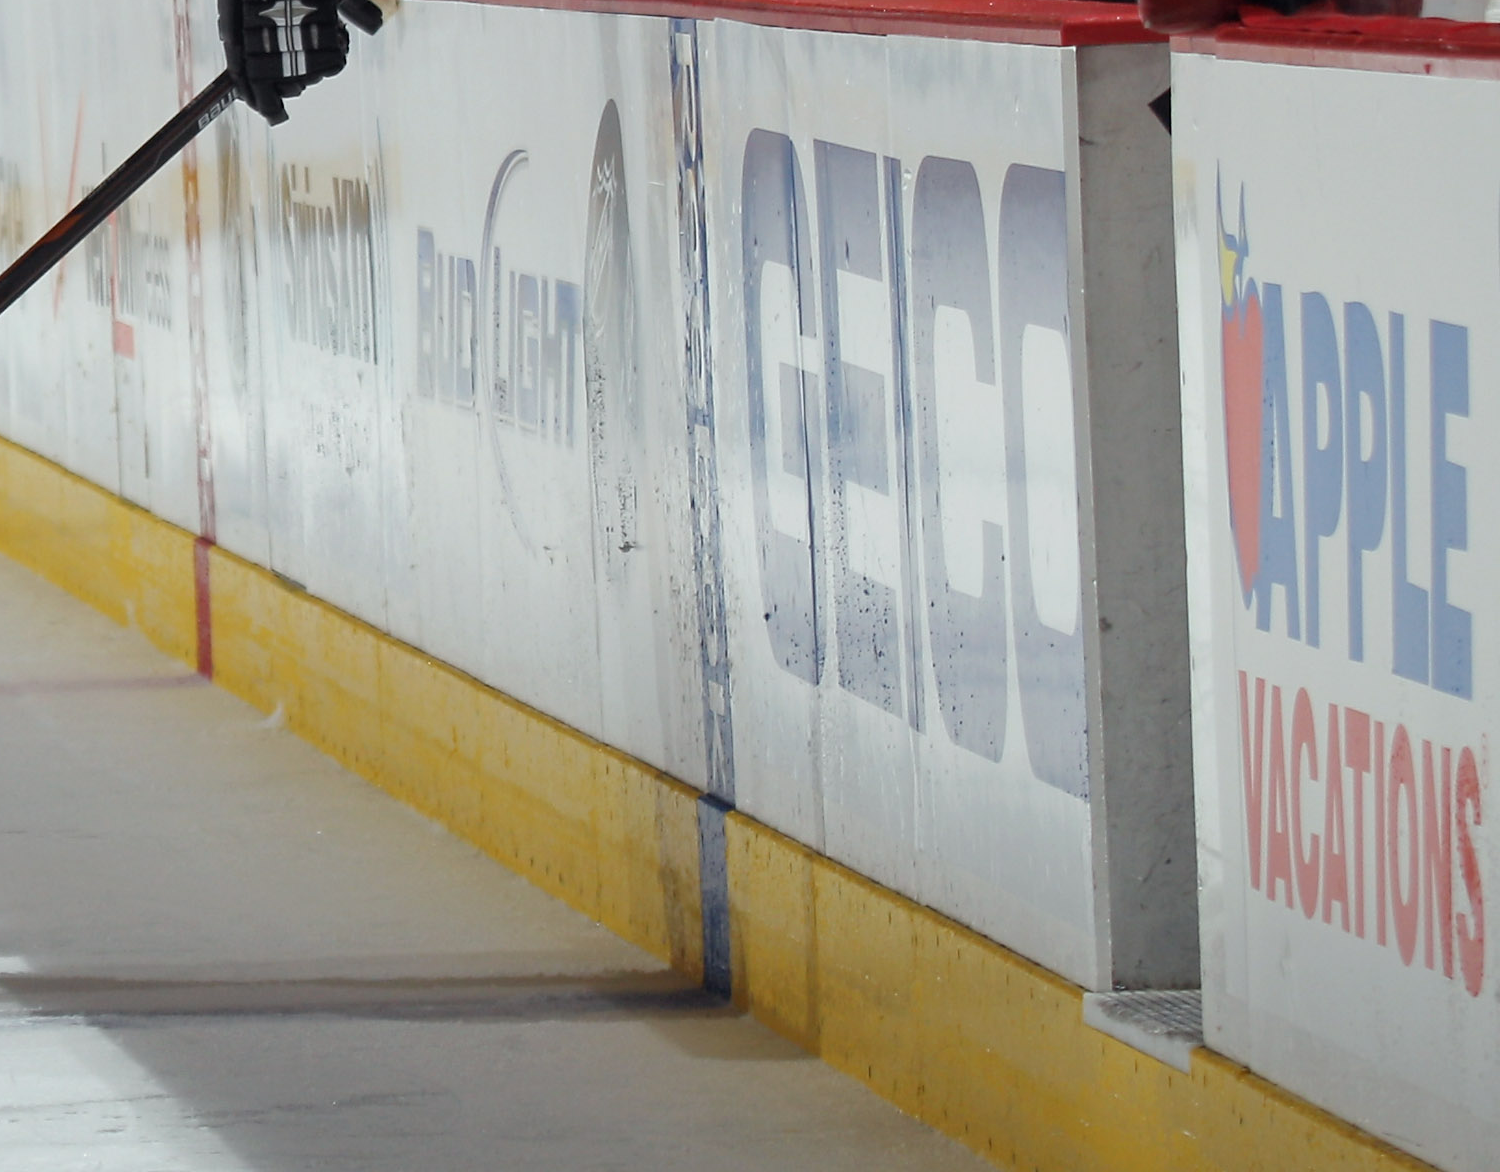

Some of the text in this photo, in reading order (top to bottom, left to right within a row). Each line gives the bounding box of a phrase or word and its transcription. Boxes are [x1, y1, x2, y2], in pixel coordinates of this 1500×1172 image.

[741, 127, 1090, 803] GEICO
[1256, 281, 1472, 700] APPLE
[1238, 669, 1484, 997] VACATIONS
